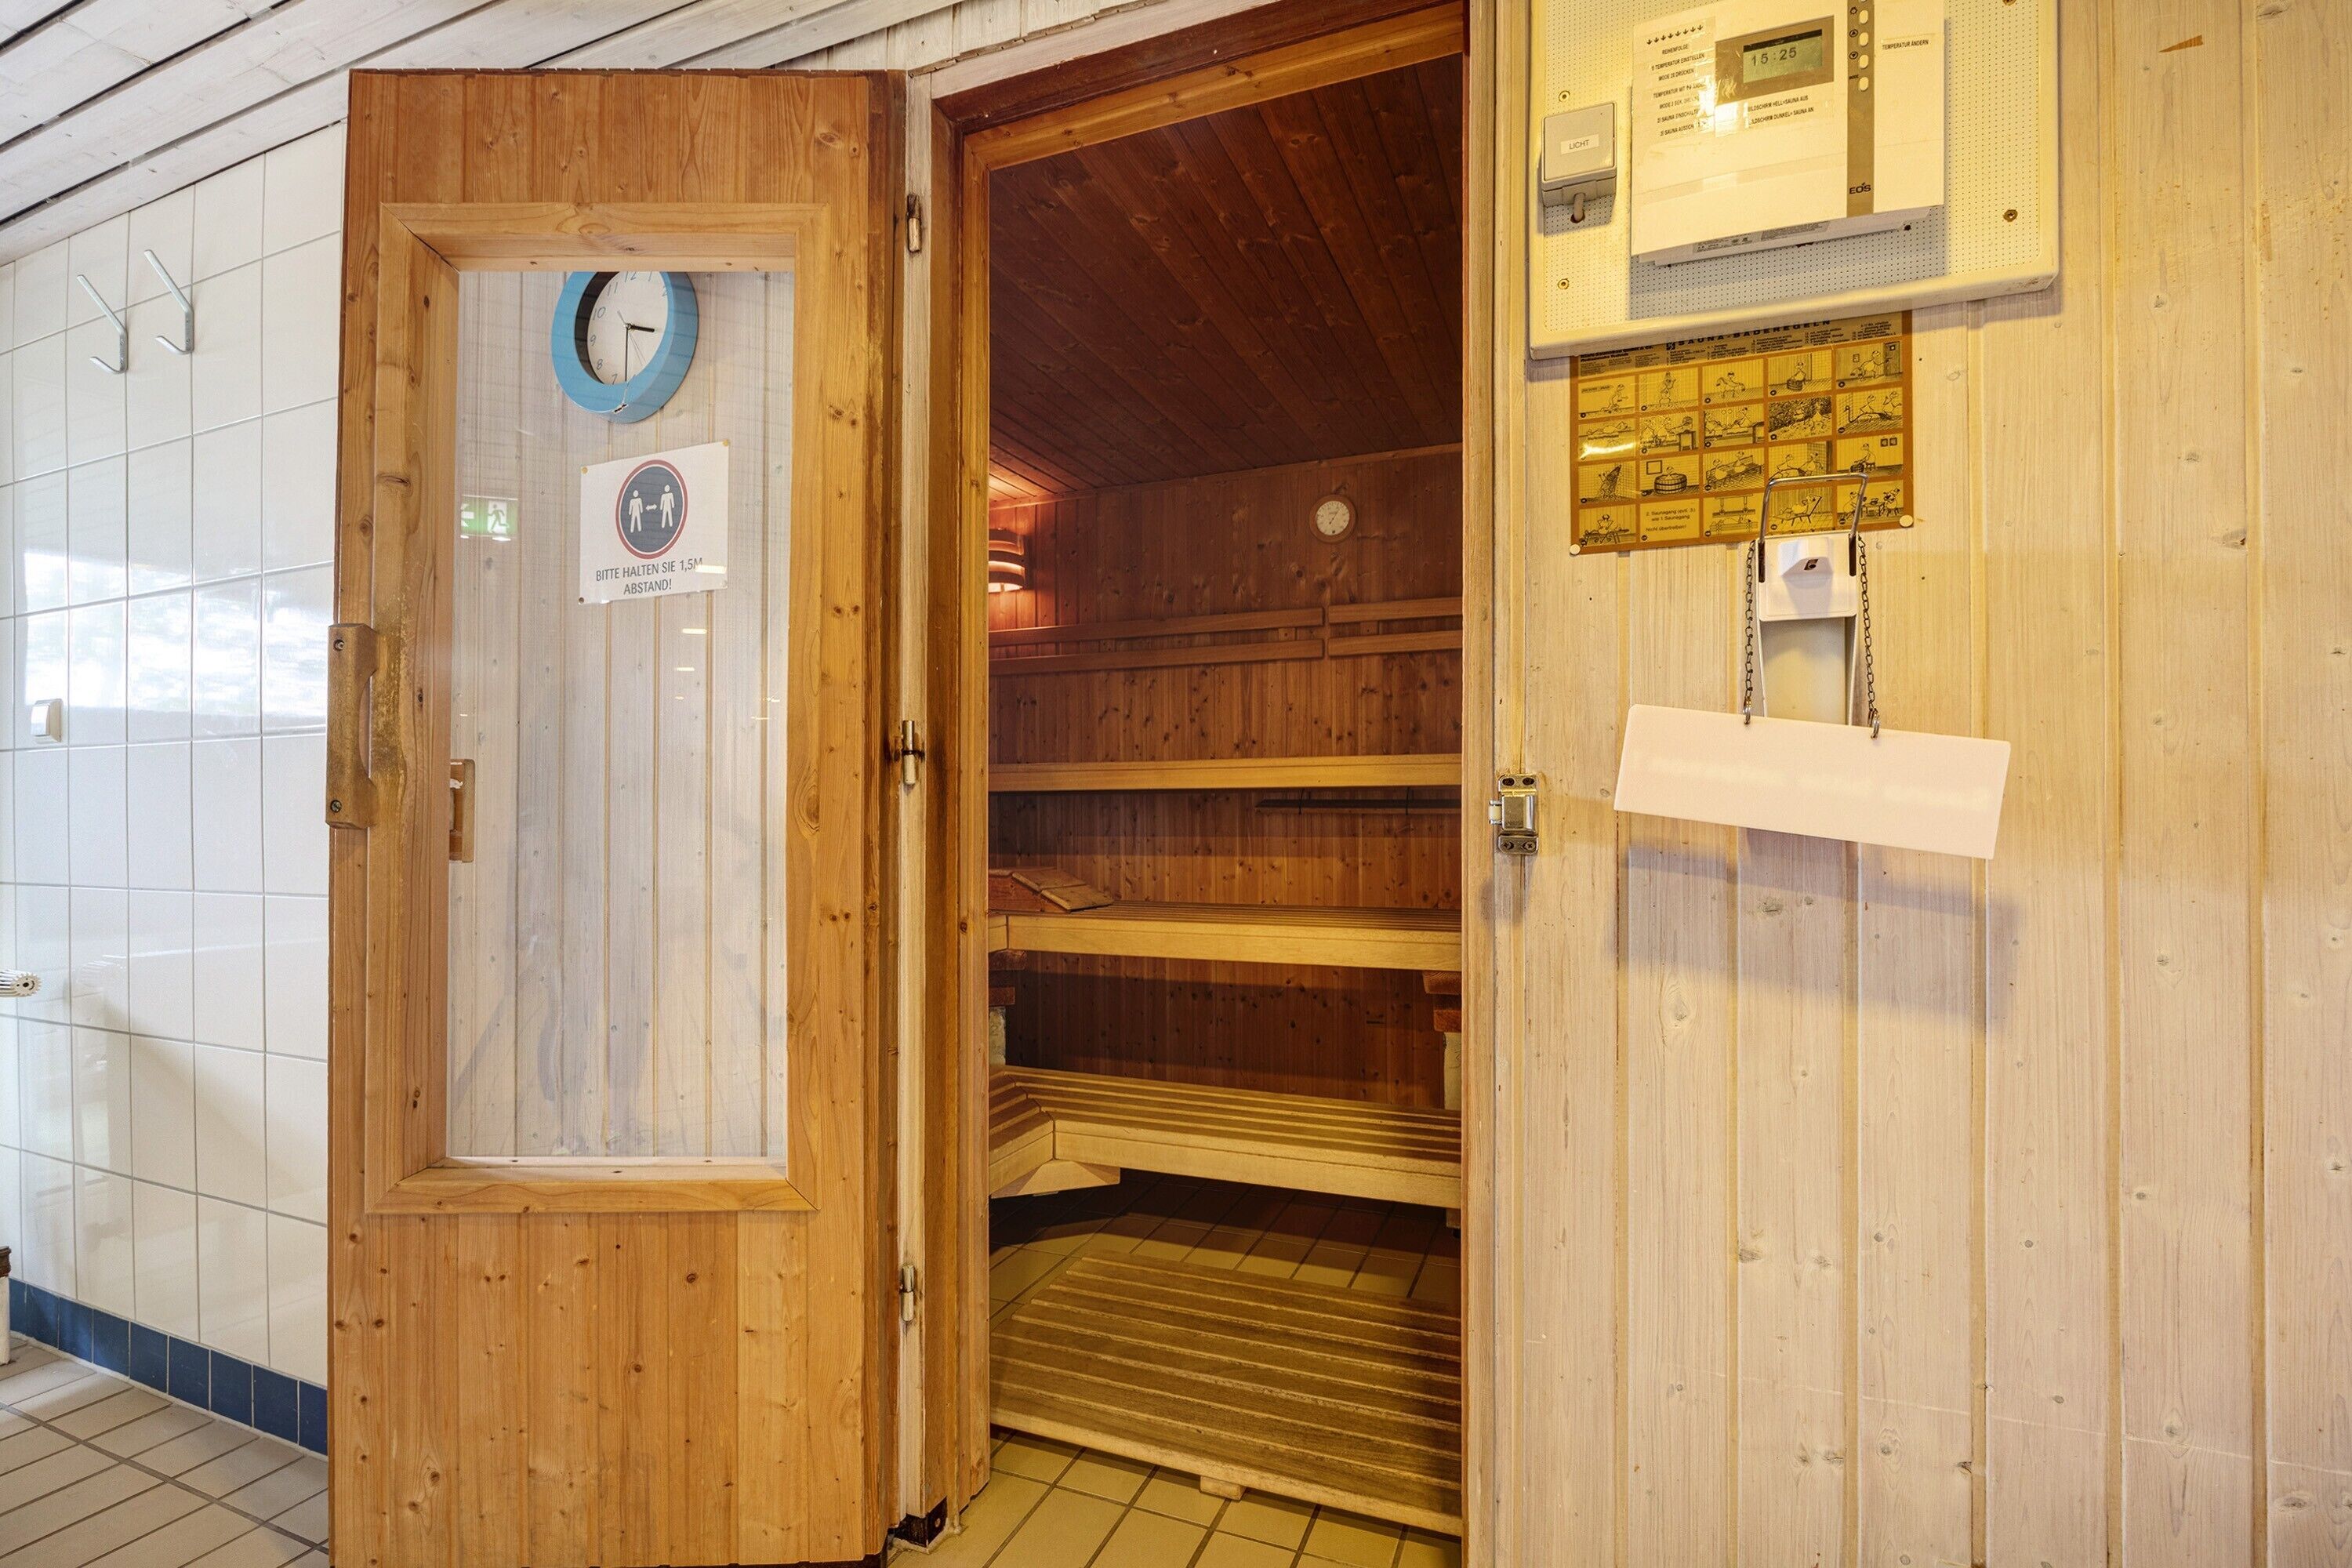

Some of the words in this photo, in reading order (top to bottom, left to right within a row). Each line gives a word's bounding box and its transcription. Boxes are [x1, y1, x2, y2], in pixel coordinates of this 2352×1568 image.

[1882, 41, 1910, 50] TEMPERATUR
[1655, 59, 1680, 70] TEMPERATUR
[1681, 53, 1704, 64] EINSTELLEN
[1751, 47, 1797, 66] 15:25
[1653, 88, 1678, 99] TEMPERATUR
[1569, 140, 1589, 150] LICHT
[1849, 183, 1871, 194] EOS
[608, 282, 619, 296] 11
[593, 307, 606, 321] 10
[590, 335, 597, 347] 9
[596, 358, 604, 371] 8
[596, 568, 619, 581] BITTE
[622, 563, 659, 578] HALTEN
[662, 561, 676, 573] SIE
[623, 579, 672, 595] ABSTAND!
